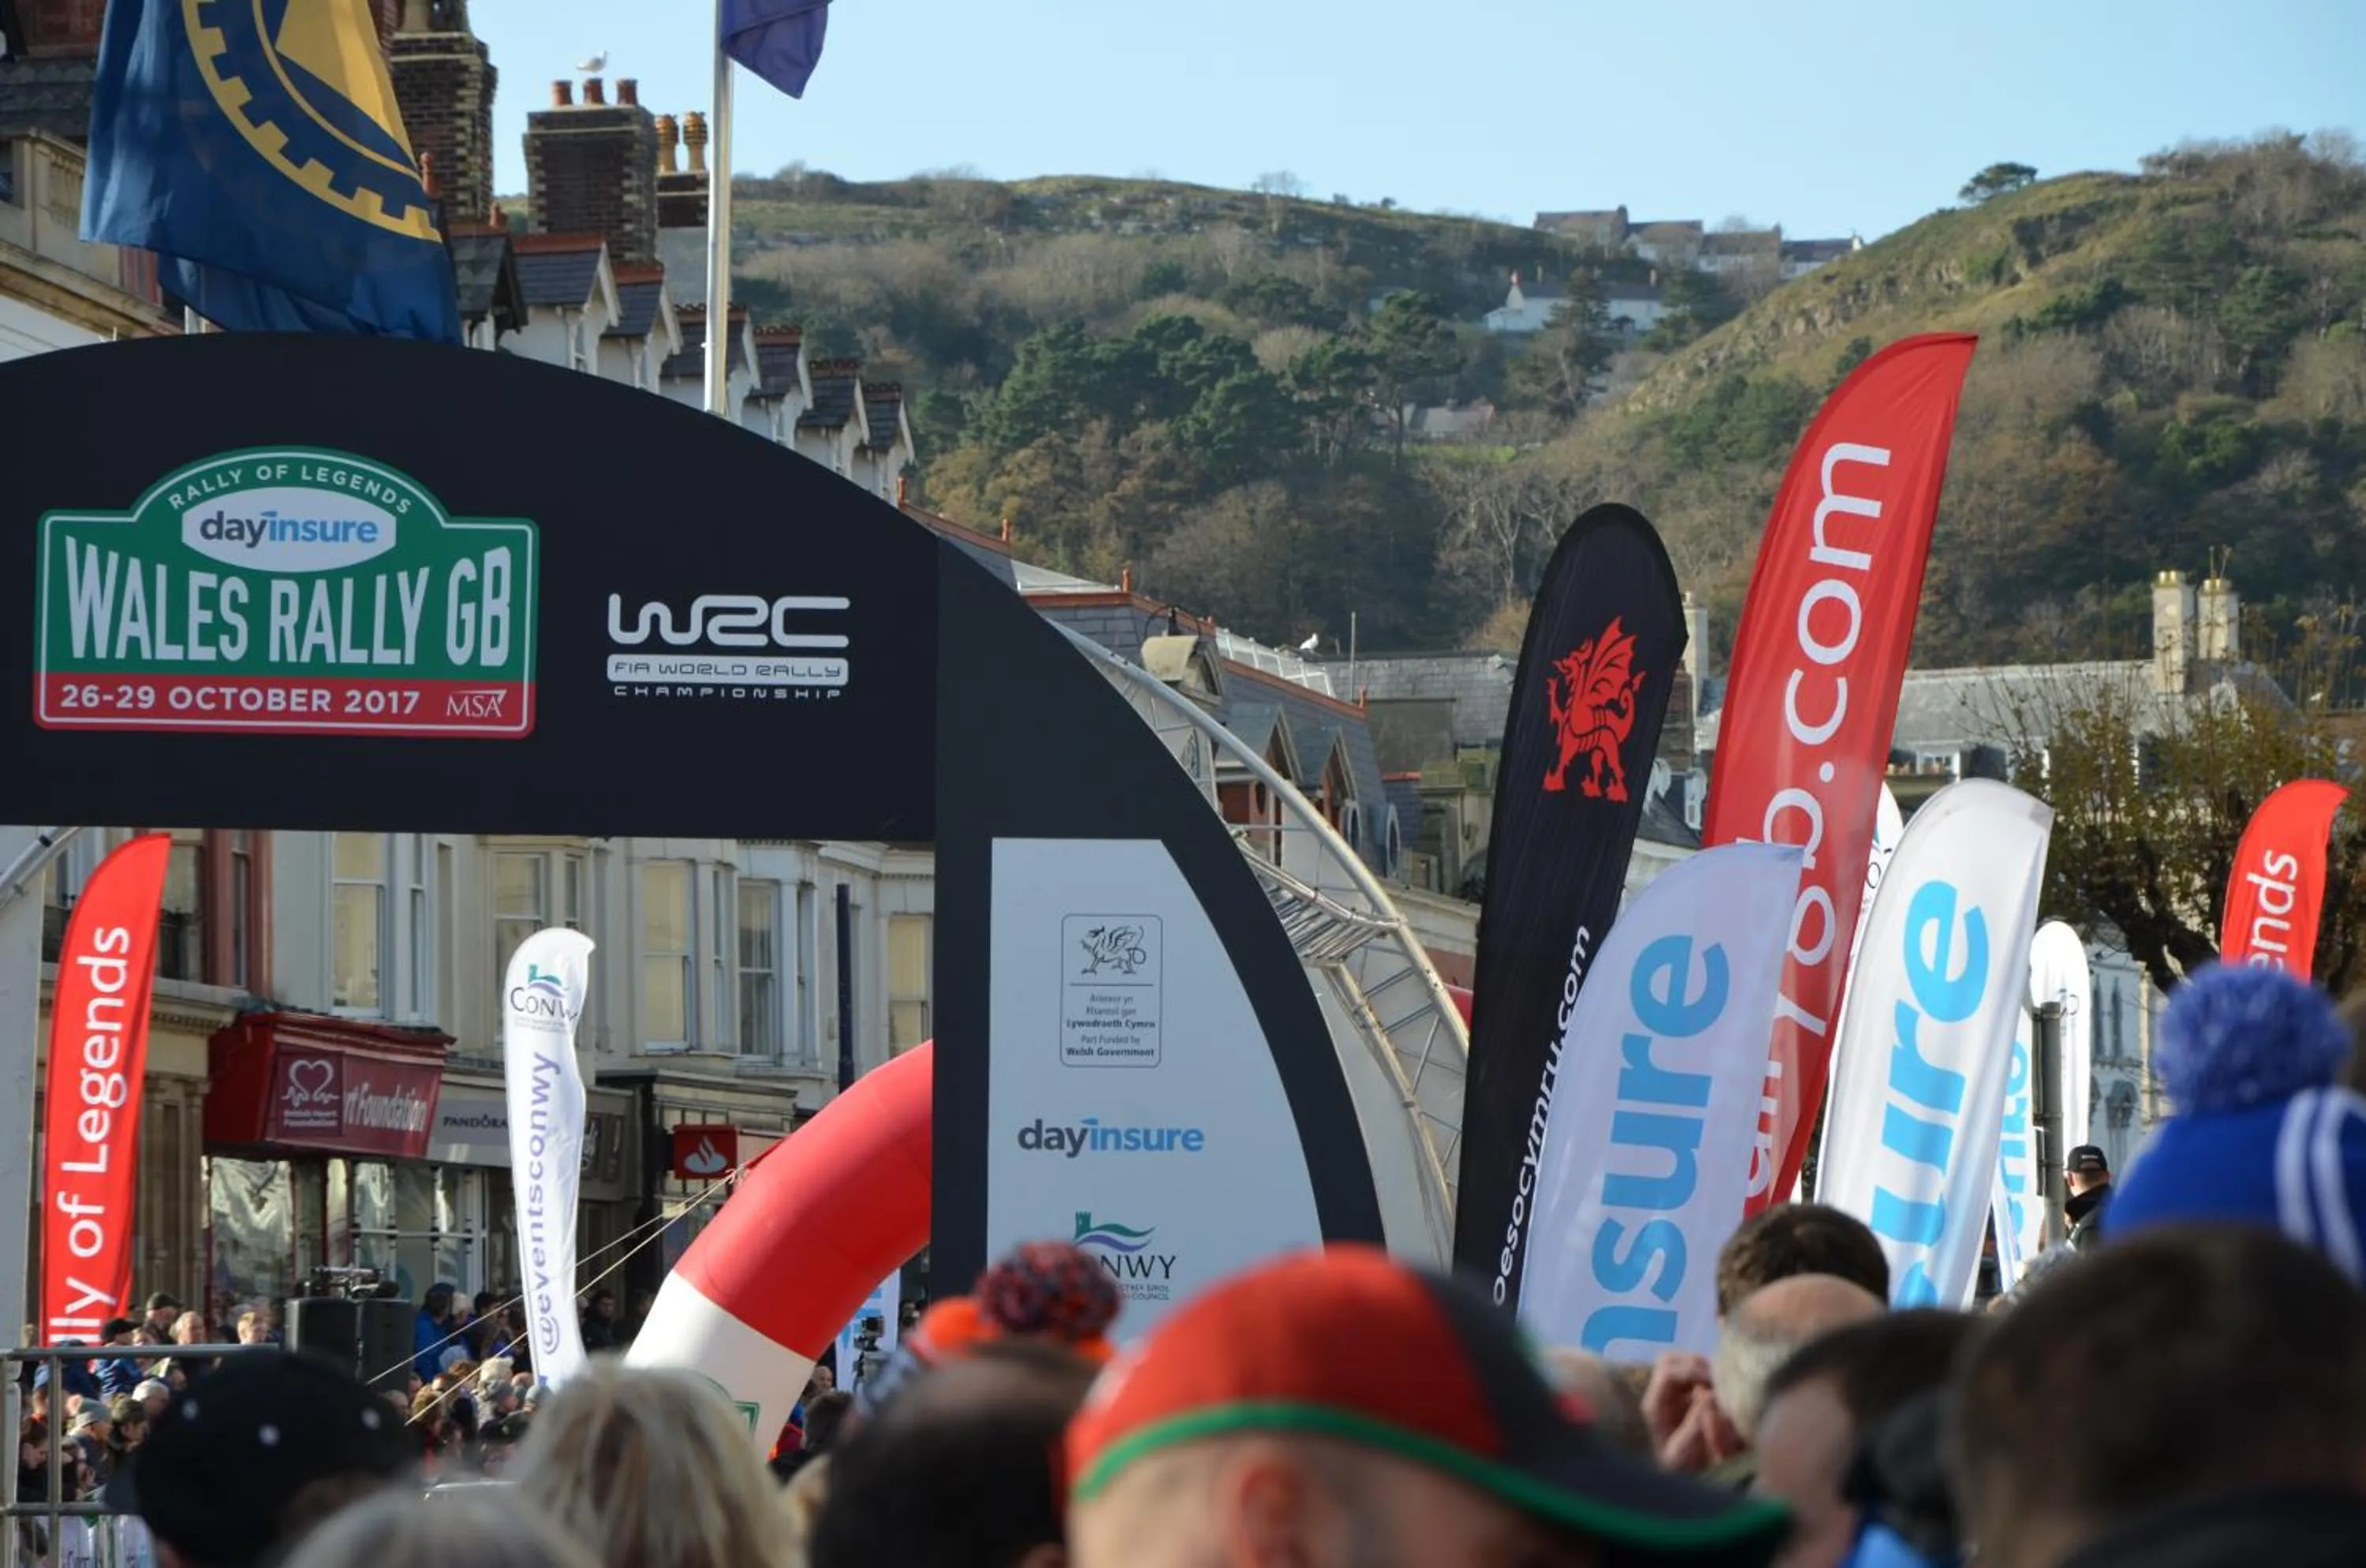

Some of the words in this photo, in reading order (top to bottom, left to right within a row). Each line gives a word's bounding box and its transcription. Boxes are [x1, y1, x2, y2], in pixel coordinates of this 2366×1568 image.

[169, 468, 244, 511] RALLY
[256, 464, 289, 482] OF
[300, 465, 412, 514] LEGENDS
[199, 510, 379, 548] dayinsure
[65, 534, 249, 662] WALES
[268, 566, 431, 666] RALLY
[446, 546, 512, 667] GB
[608, 593, 850, 647] WRC
[614, 662, 651, 674] FIA
[659, 663, 748, 675] WORLD
[756, 665, 842, 678] RALLY
[61, 684, 156, 708] 26-29
[168, 686, 332, 712] OCTOBER
[345, 690, 420, 715] 2017
[446, 689, 507, 718] MSA
[614, 685, 842, 700] CHAMPIONSHIP
[1125, 1019, 1155, 1031] Cymru
[61, 926, 130, 1173] Legends
[1066, 1046, 1094, 1056] Welsh
[1096, 1047, 1154, 1057] Government
[1017, 1117, 1205, 1159] dayinsure
[528, 1051, 562, 1355] @eventsconwy
[58, 1191, 106, 1257] of
